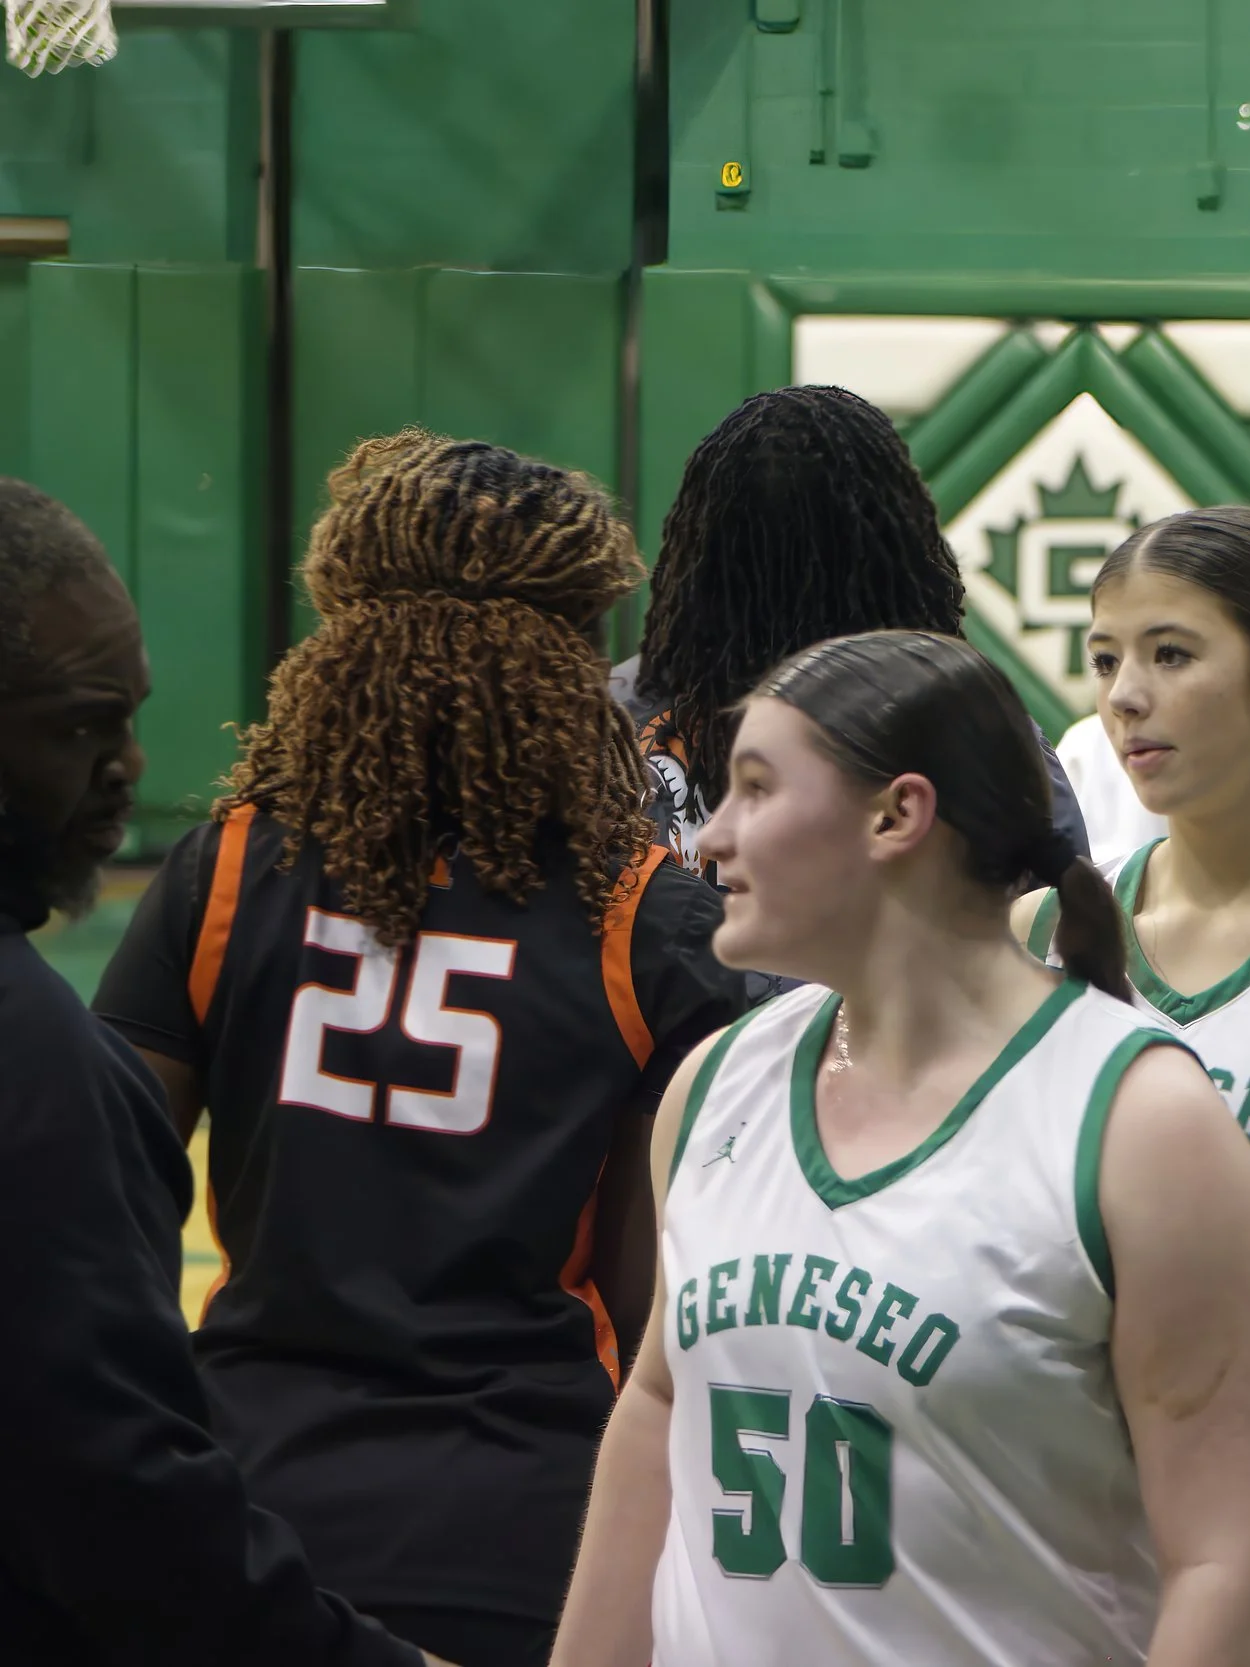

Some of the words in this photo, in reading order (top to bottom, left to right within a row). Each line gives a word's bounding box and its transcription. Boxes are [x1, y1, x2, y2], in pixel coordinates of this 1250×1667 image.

[277, 905, 519, 1136] 25
[676, 1252, 961, 1388] GENESEO
[707, 1382, 896, 1591] 50
